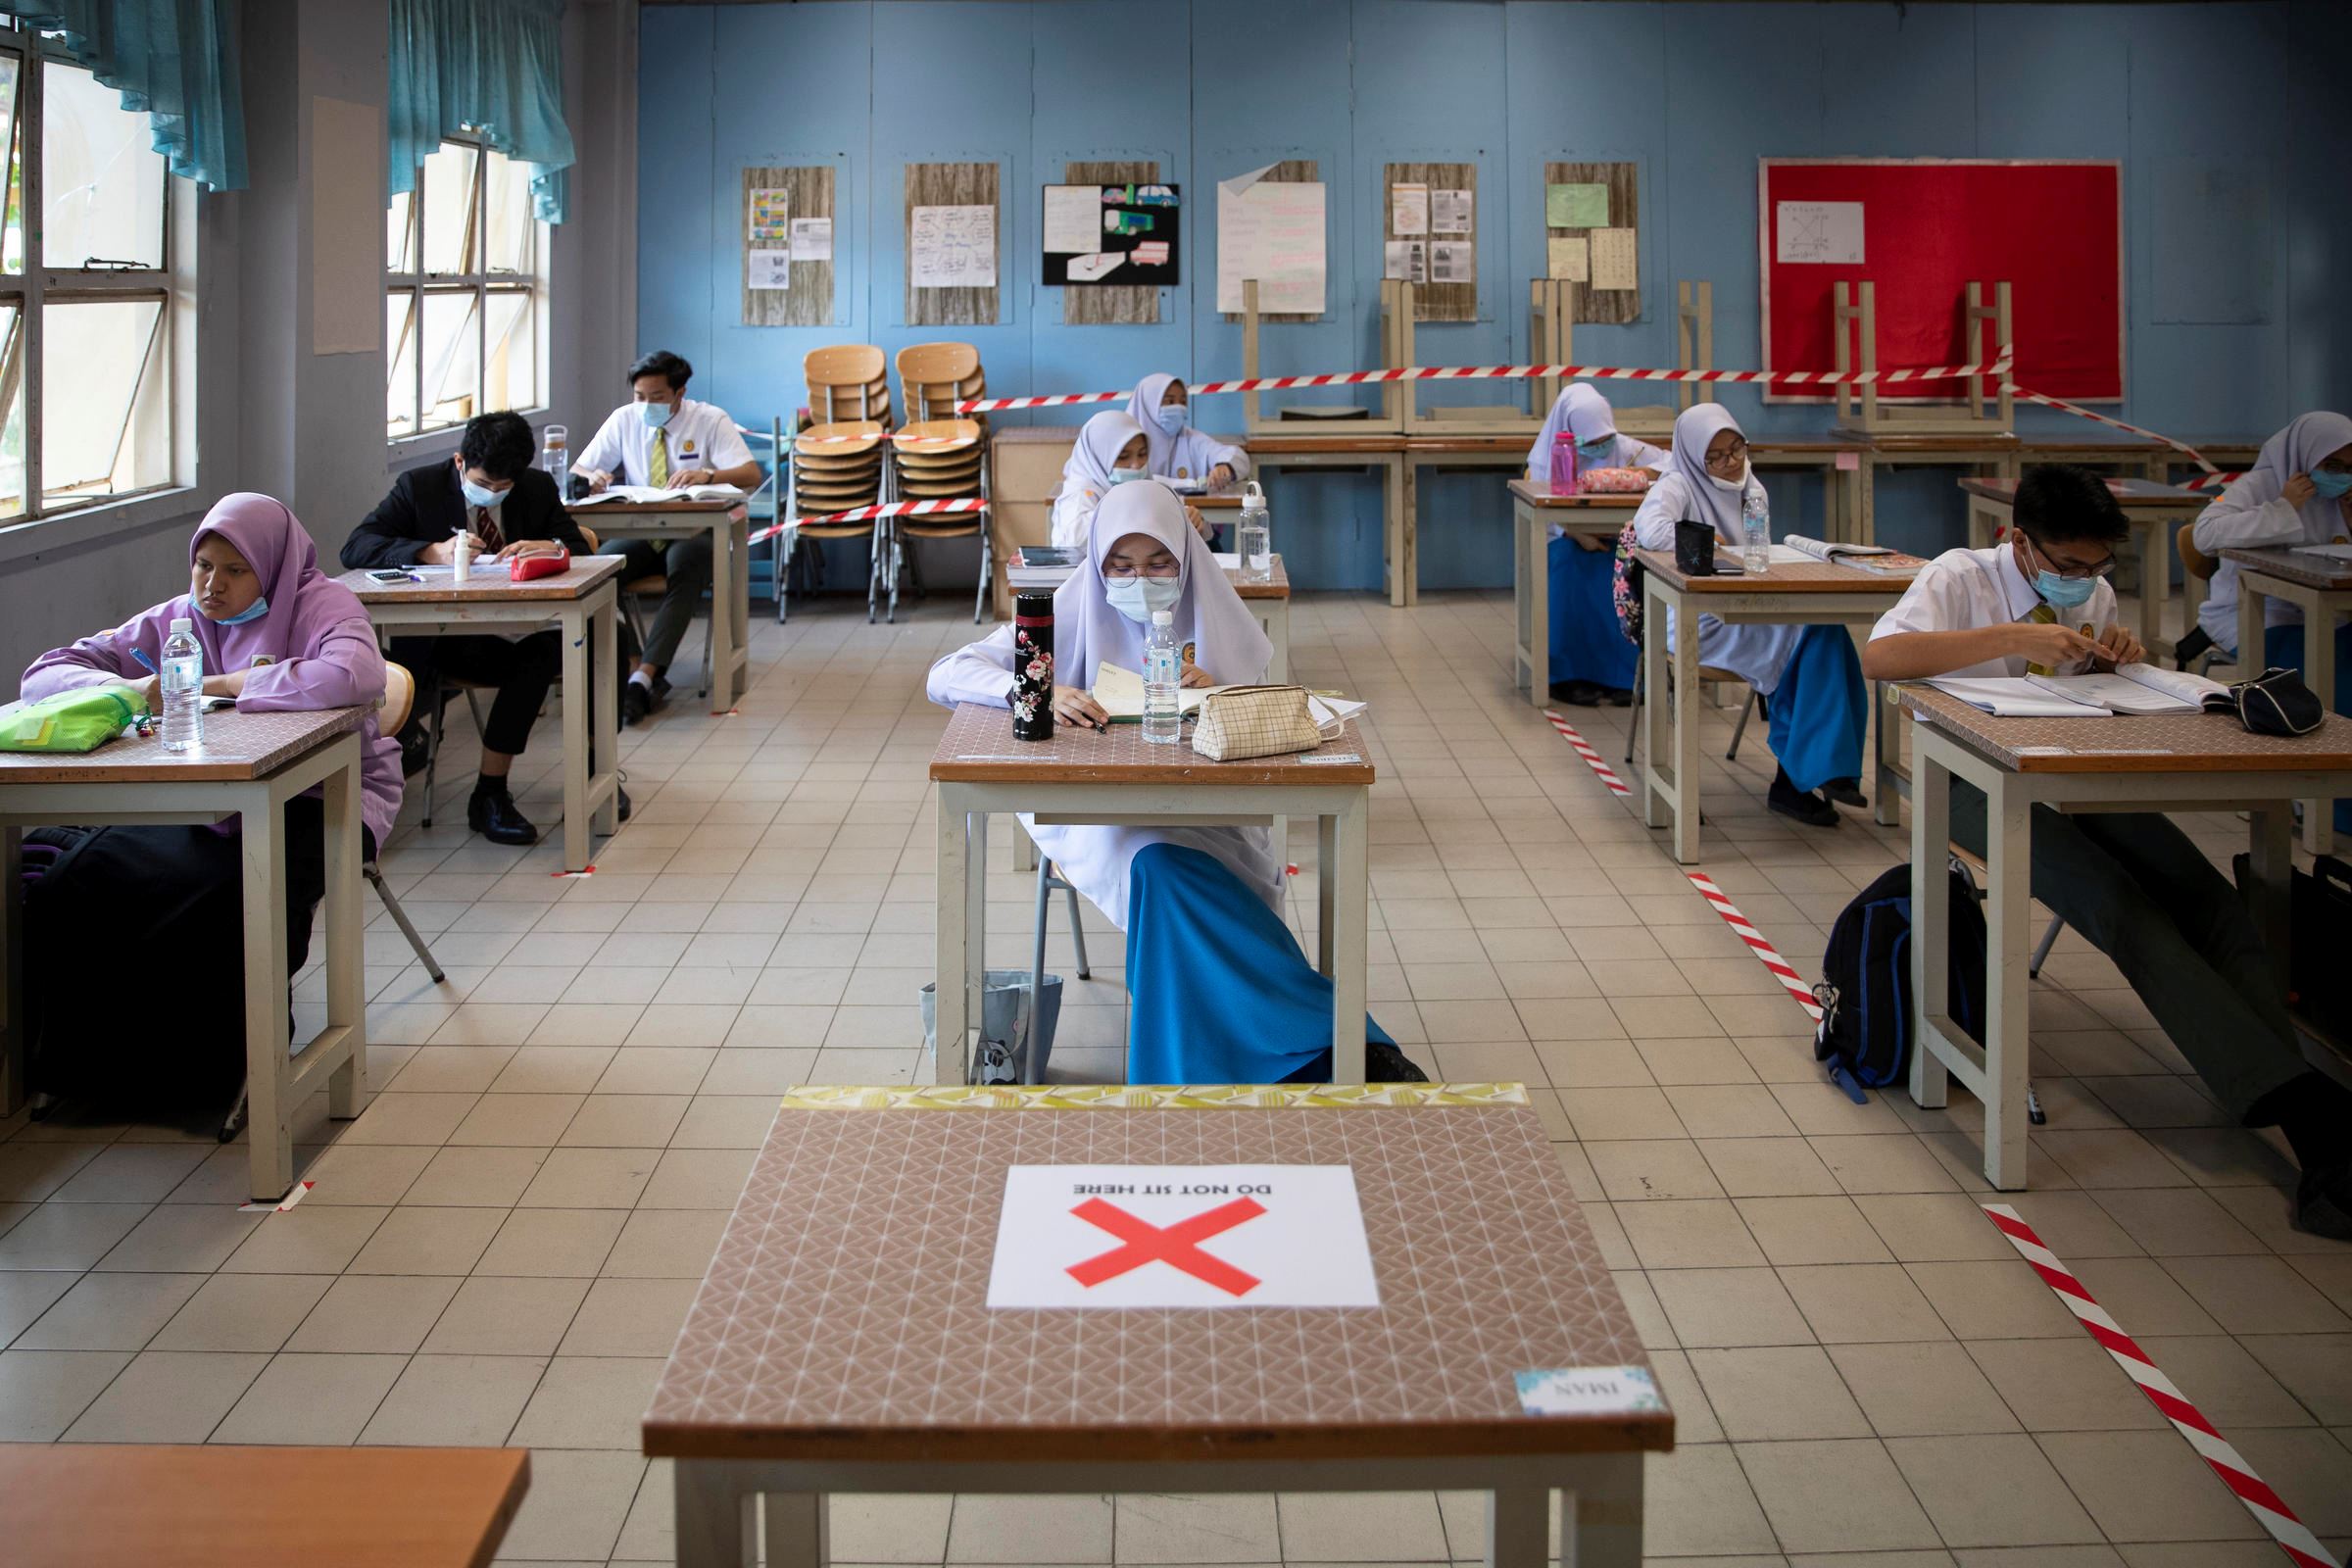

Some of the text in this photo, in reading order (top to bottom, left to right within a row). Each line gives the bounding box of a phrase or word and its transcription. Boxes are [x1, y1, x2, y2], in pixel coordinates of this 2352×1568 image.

[1073, 1184, 1272, 1196] DO NOT SIT HERE
[1554, 1380, 1620, 1396] IMAN
